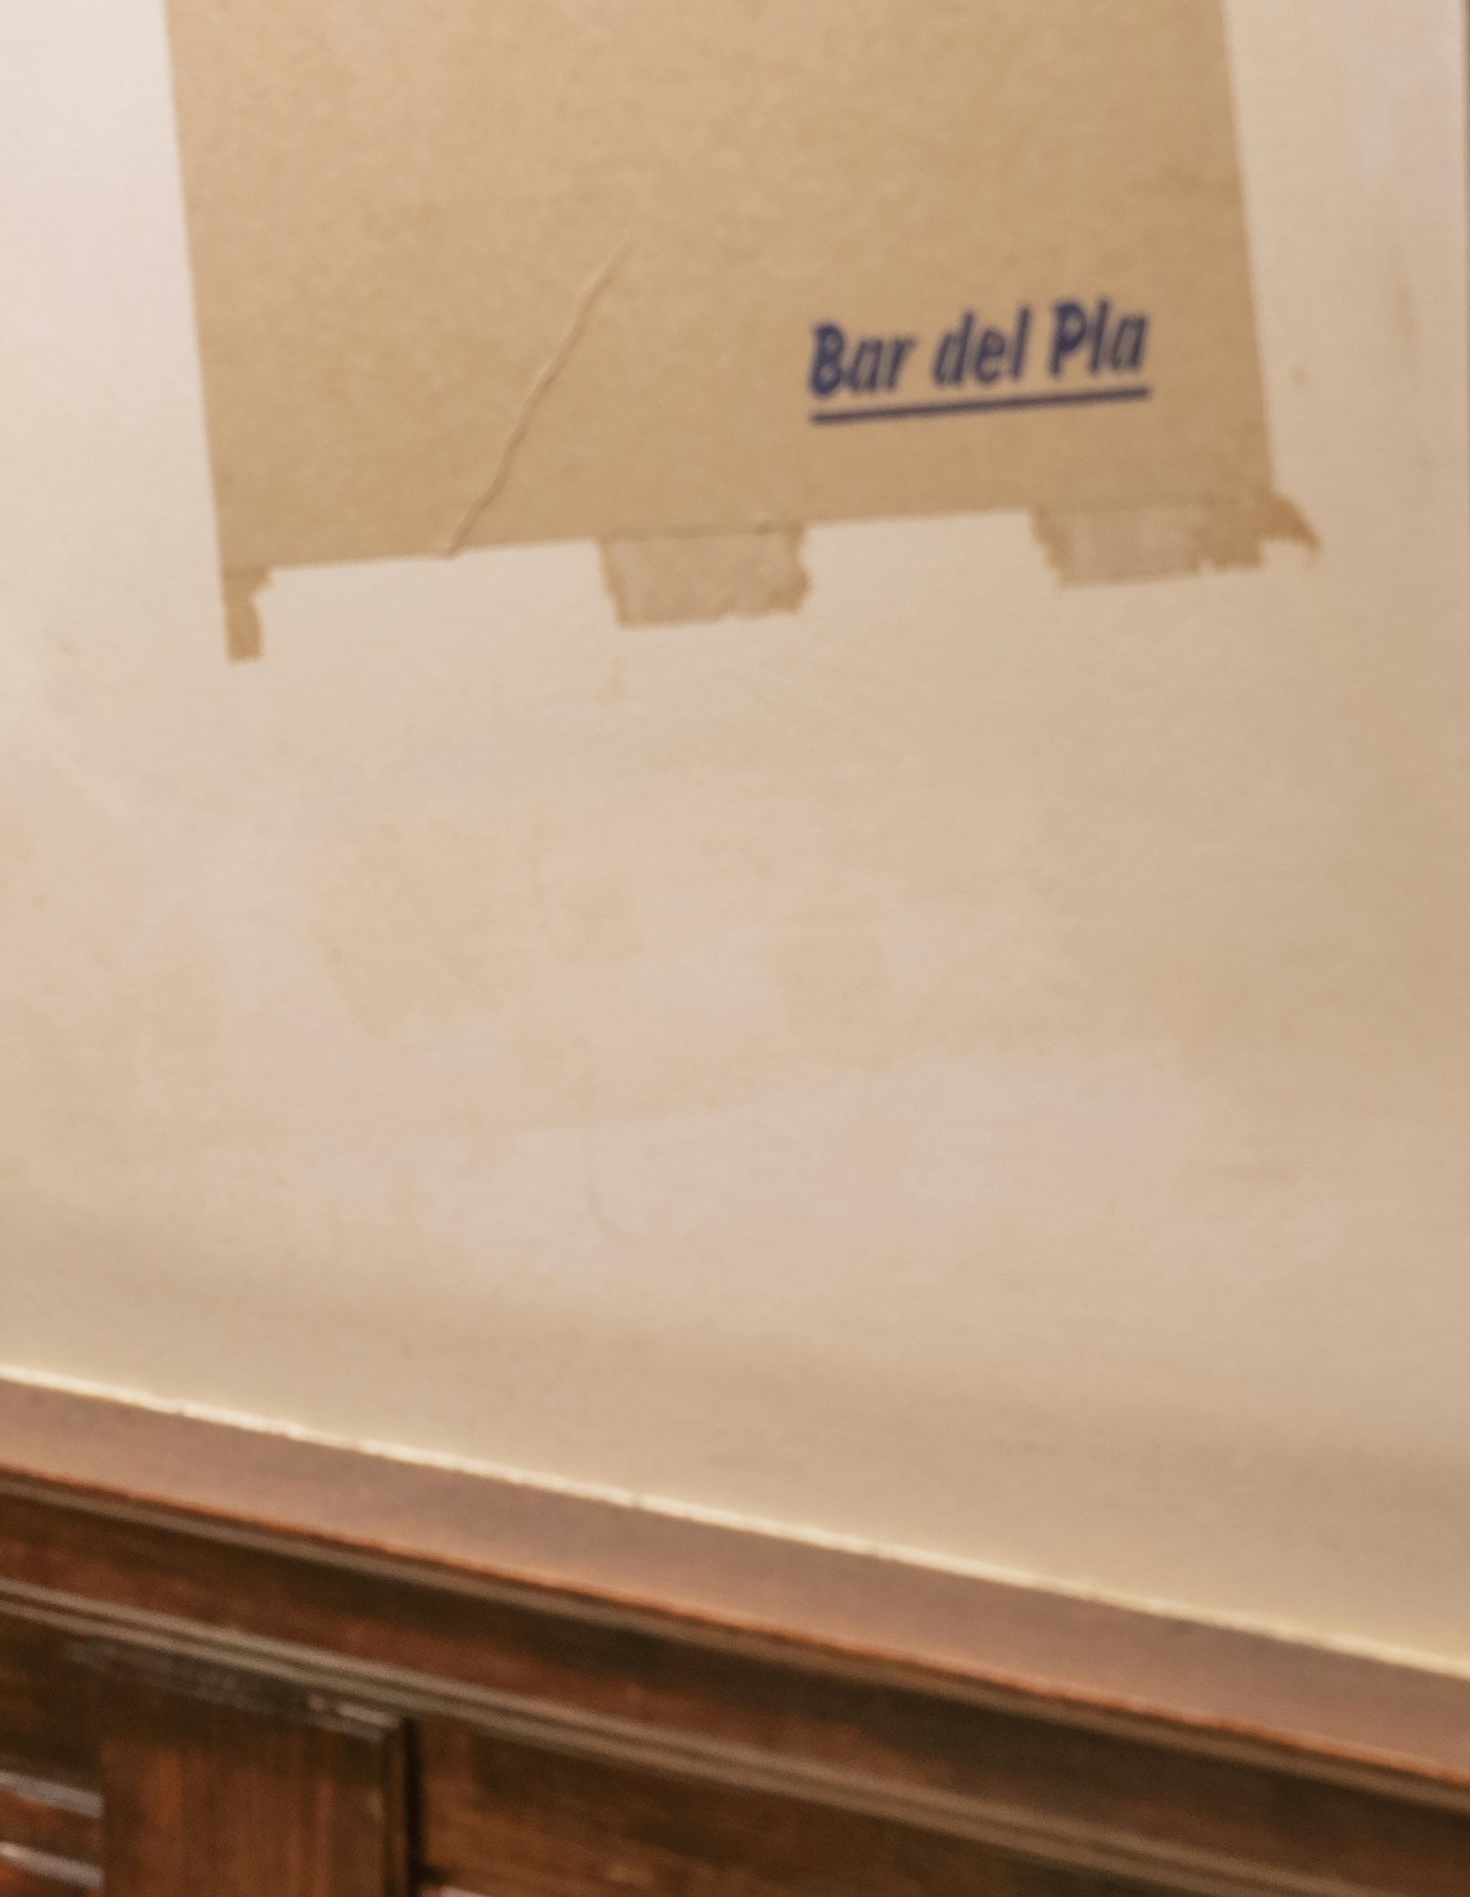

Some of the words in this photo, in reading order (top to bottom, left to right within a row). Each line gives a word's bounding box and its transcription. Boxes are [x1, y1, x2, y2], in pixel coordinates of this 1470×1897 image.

[808, 322, 917, 400] Bar
[931, 305, 1026, 390] del
[1049, 297, 1149, 379] Pla
